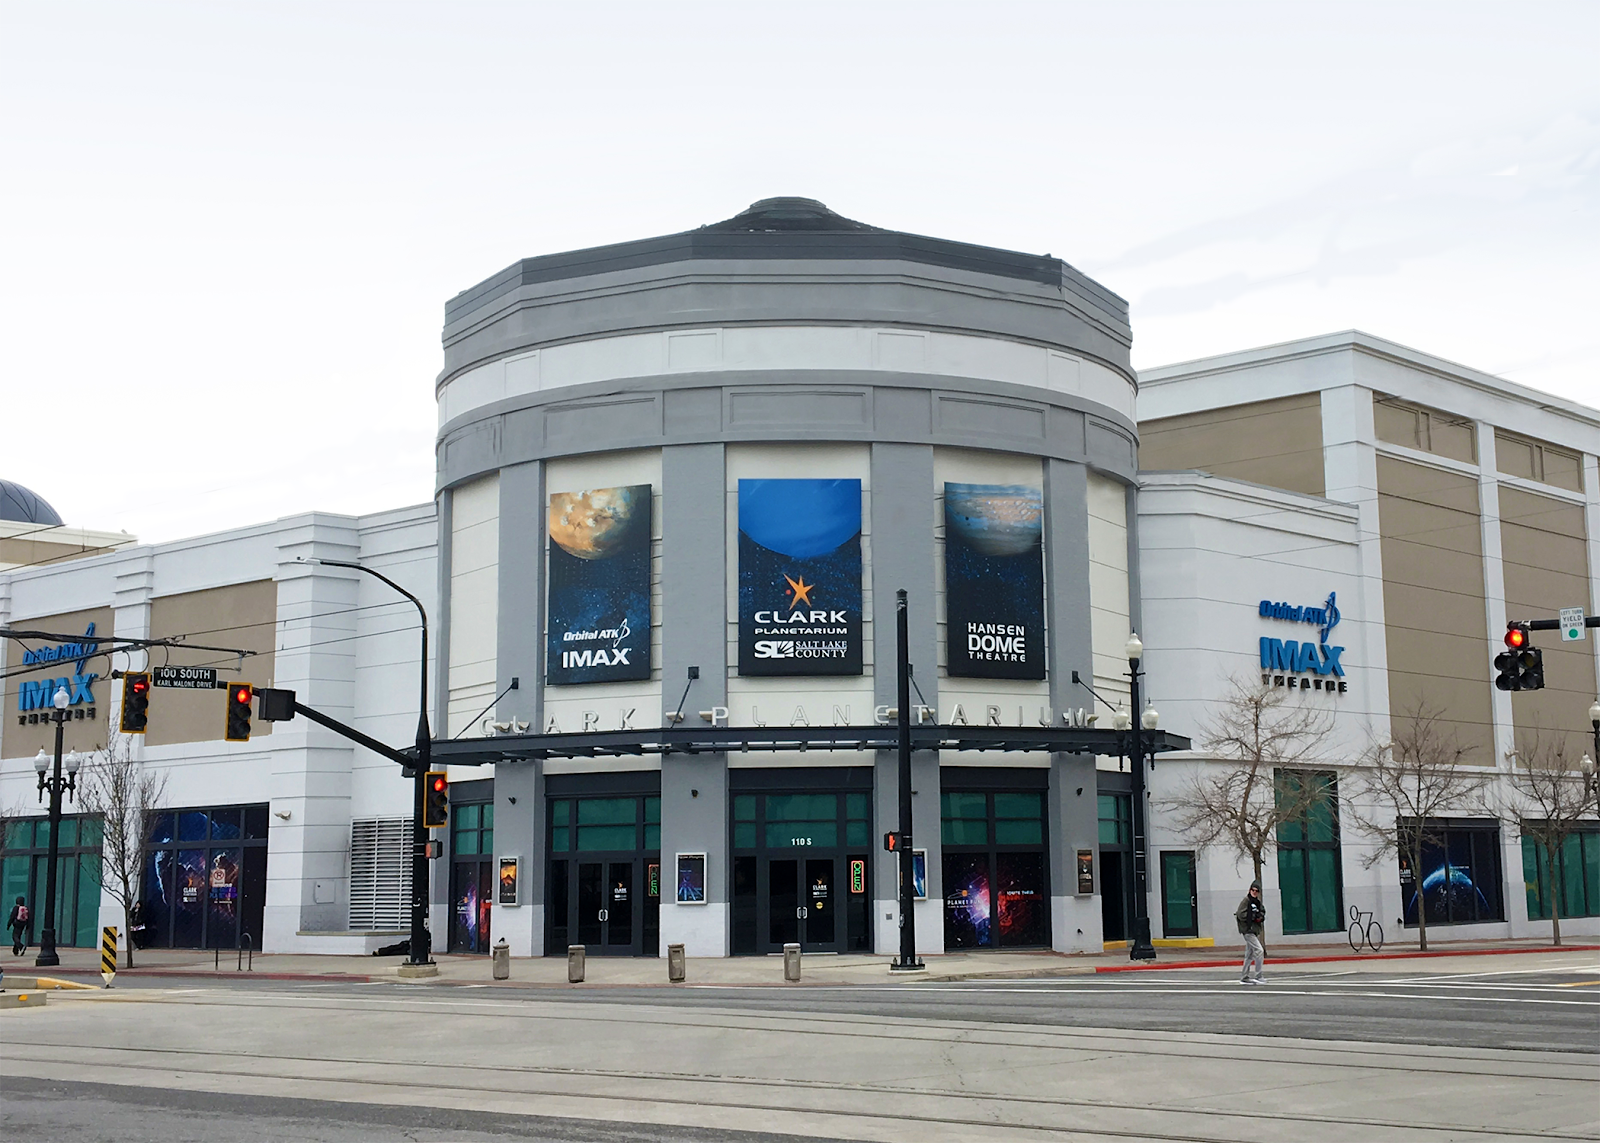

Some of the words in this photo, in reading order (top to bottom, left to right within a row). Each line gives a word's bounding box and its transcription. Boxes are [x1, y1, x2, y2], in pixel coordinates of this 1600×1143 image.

[754, 610, 847, 624] CLARK
[1260, 600, 1303, 622] Orbital
[1303, 607, 1327, 624] ATK
[563, 629, 598, 641] Orbital
[598, 628, 620, 639] ATK
[754, 627, 847, 635] PLANETARIUM
[968, 622, 1024, 636] HANSEN
[968, 634, 1025, 653] DOME
[22, 645, 60, 666] Orbital
[60, 643, 84, 659] ATK
[563, 648, 631, 668] IMAX
[795, 649, 847, 658] COUNTY
[968, 651, 1026, 662] THEATRE
[1260, 637, 1346, 676] IMAX
[160, 668, 176, 678] 100
[180, 669, 210, 679] SOUTH
[18, 674, 97, 711] IMAX
[1262, 674, 1347, 693] THEATRE
[479, 708, 636, 737] CLARK
[710, 704, 1090, 728] PLANETARIUM
[791, 837, 805, 846] 110
[806, 837, 812, 846] S
[650, 866, 658, 894] OPEN
[853, 862, 862, 891] OPEN
